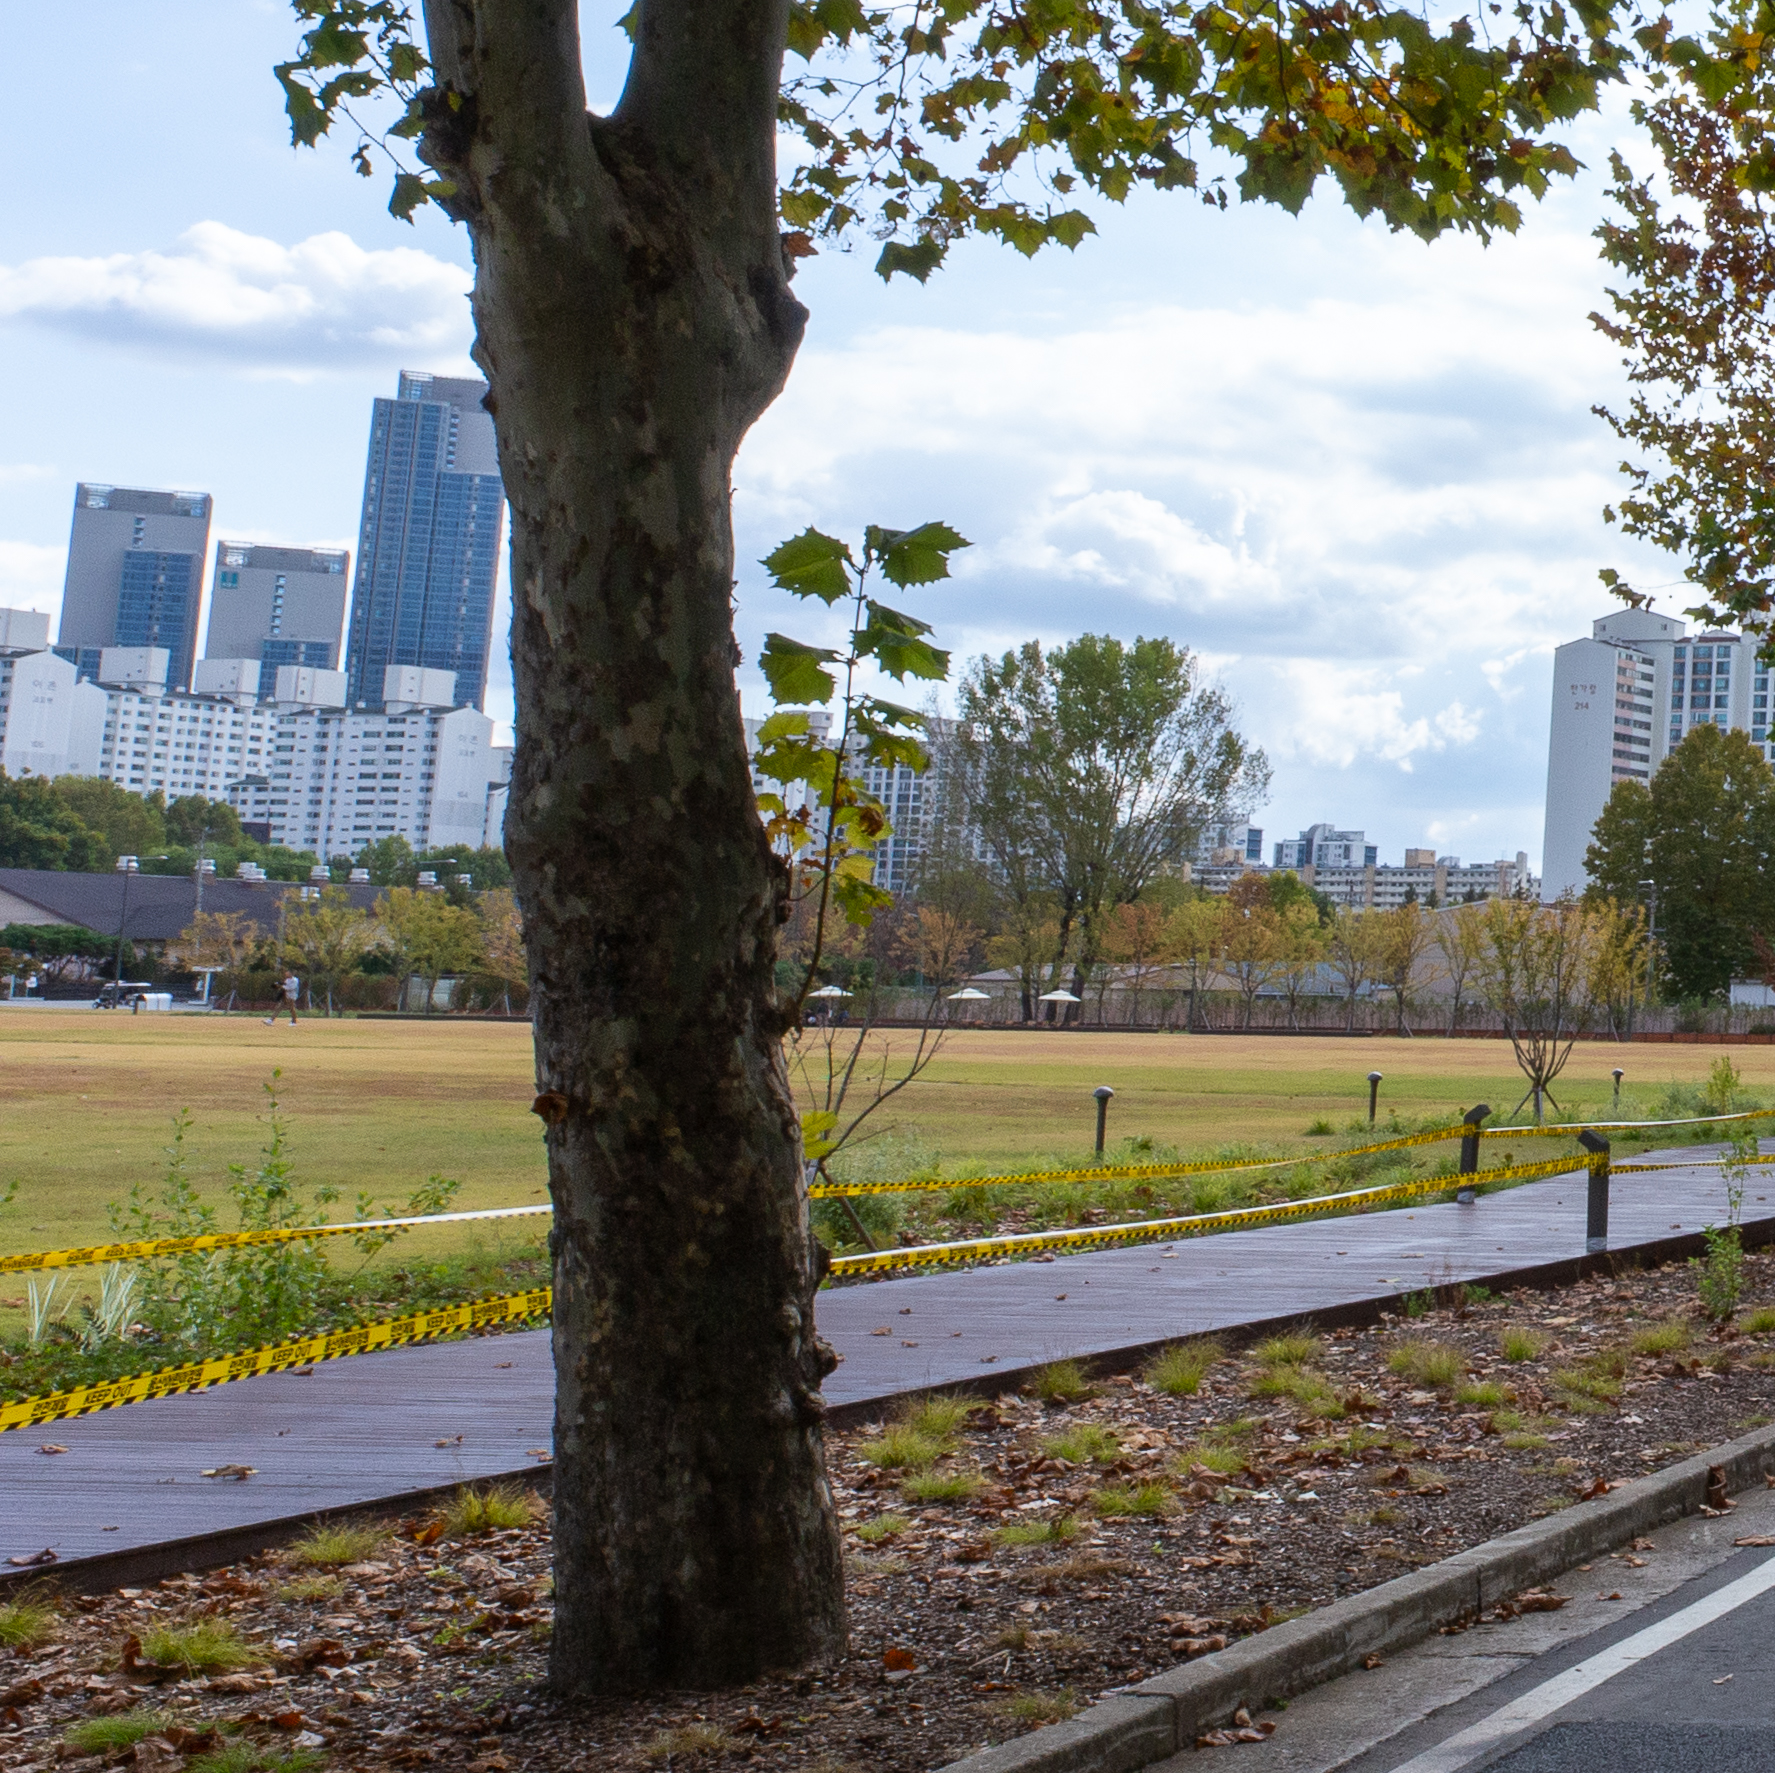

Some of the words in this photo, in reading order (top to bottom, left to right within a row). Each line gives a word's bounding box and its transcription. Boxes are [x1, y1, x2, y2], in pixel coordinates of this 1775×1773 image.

[1574, 701, 1589, 710] 214
[83, 1386, 109, 1405] KEEP
[112, 1382, 135, 1400] OUT
[271, 1347, 295, 1363] KEEP
[295, 1343, 314, 1359] OUT
